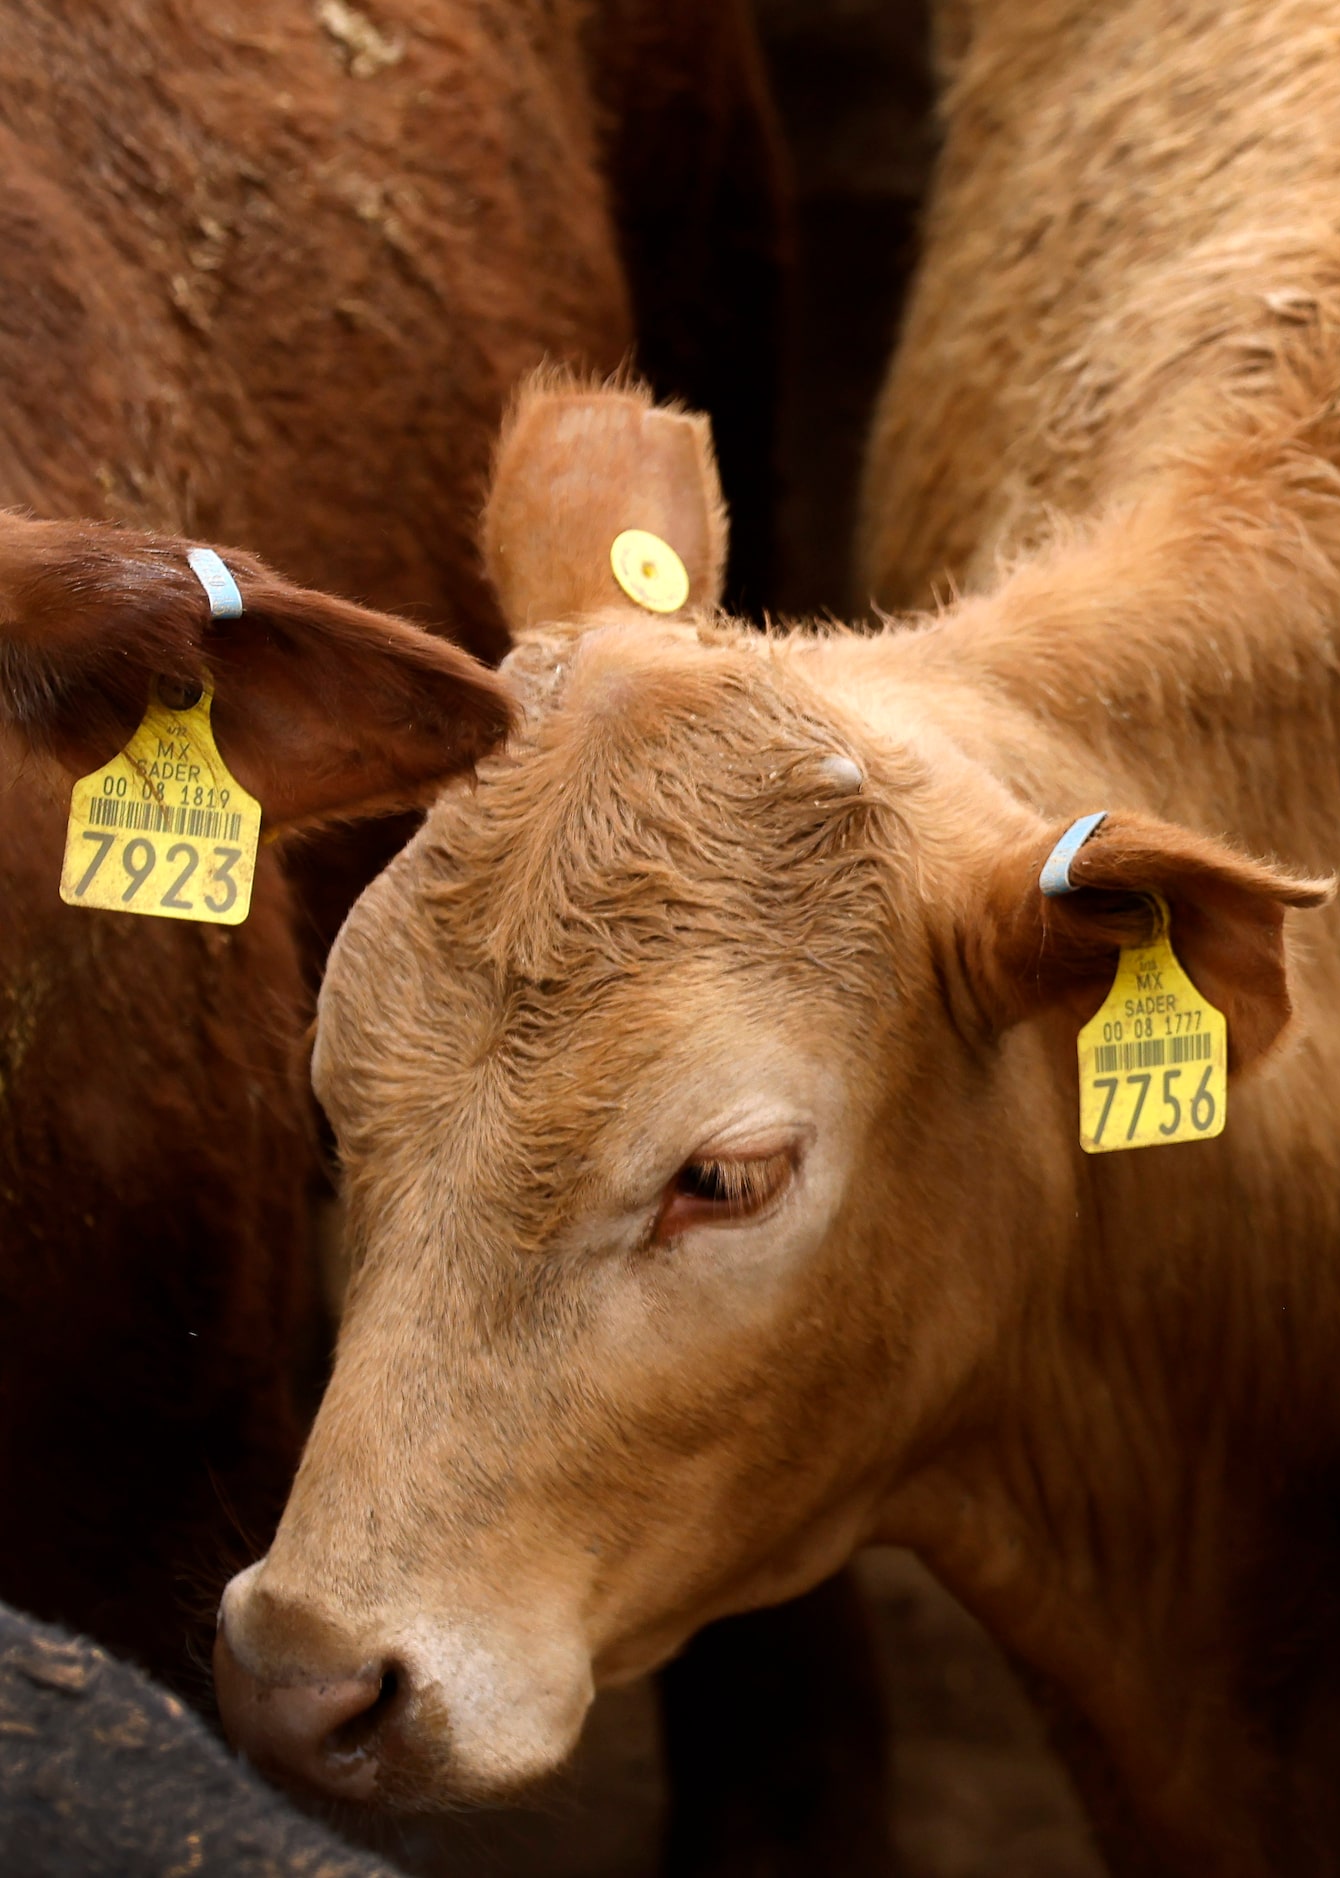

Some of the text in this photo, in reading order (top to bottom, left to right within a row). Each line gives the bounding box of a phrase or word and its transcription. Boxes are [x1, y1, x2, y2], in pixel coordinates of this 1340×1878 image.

[156, 740, 191, 761] MX
[136, 759, 201, 783] SADER
[102, 776, 231, 809] 00 08 1819
[74, 831, 242, 913] 7923
[1136, 971, 1164, 991] MX
[1124, 994, 1177, 1018] SADER
[1103, 1011, 1203, 1042] 00 08 1777
[1093, 1065, 1215, 1144] 7756
